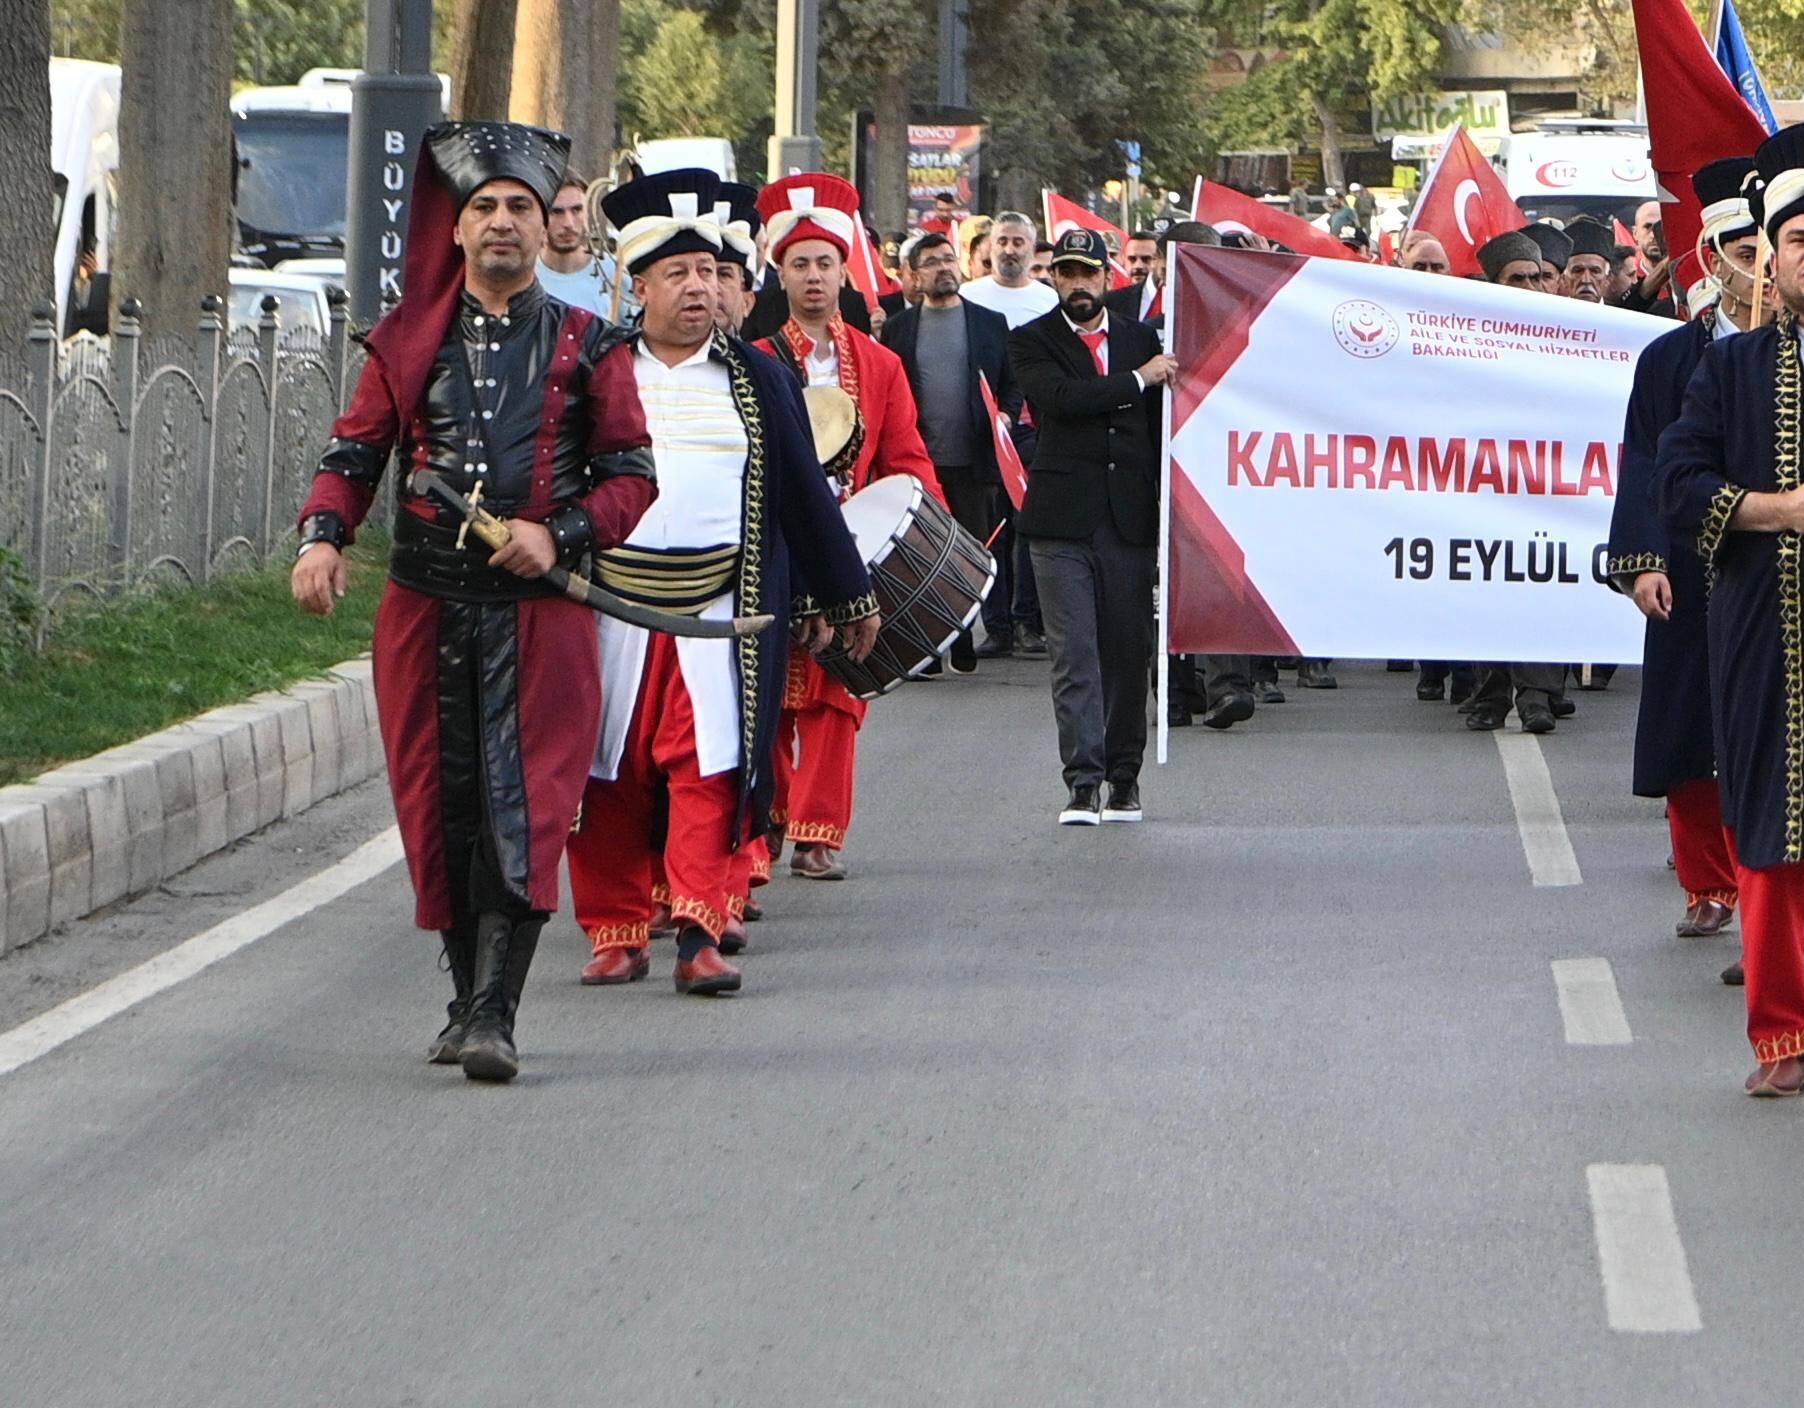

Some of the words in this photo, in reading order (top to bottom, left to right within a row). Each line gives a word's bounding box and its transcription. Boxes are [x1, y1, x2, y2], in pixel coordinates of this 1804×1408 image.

[1553, 167, 1578, 179] 112
[1406, 310, 1477, 332] TÜRKİYE
[1480, 319, 1598, 343] CUMHURİYETİ
[1410, 328, 1444, 341] AİLE
[1449, 333, 1469, 345] VE
[1474, 337, 1535, 353] SOSYAL
[1539, 344, 1631, 363] HİZMETLER
[1412, 342, 1499, 360] BAKANLIĞI
[1227, 430, 1623, 497] KAHRAMANLA
[1383, 537, 1435, 581] 19
[1448, 530, 1580, 585] EYLÜL
